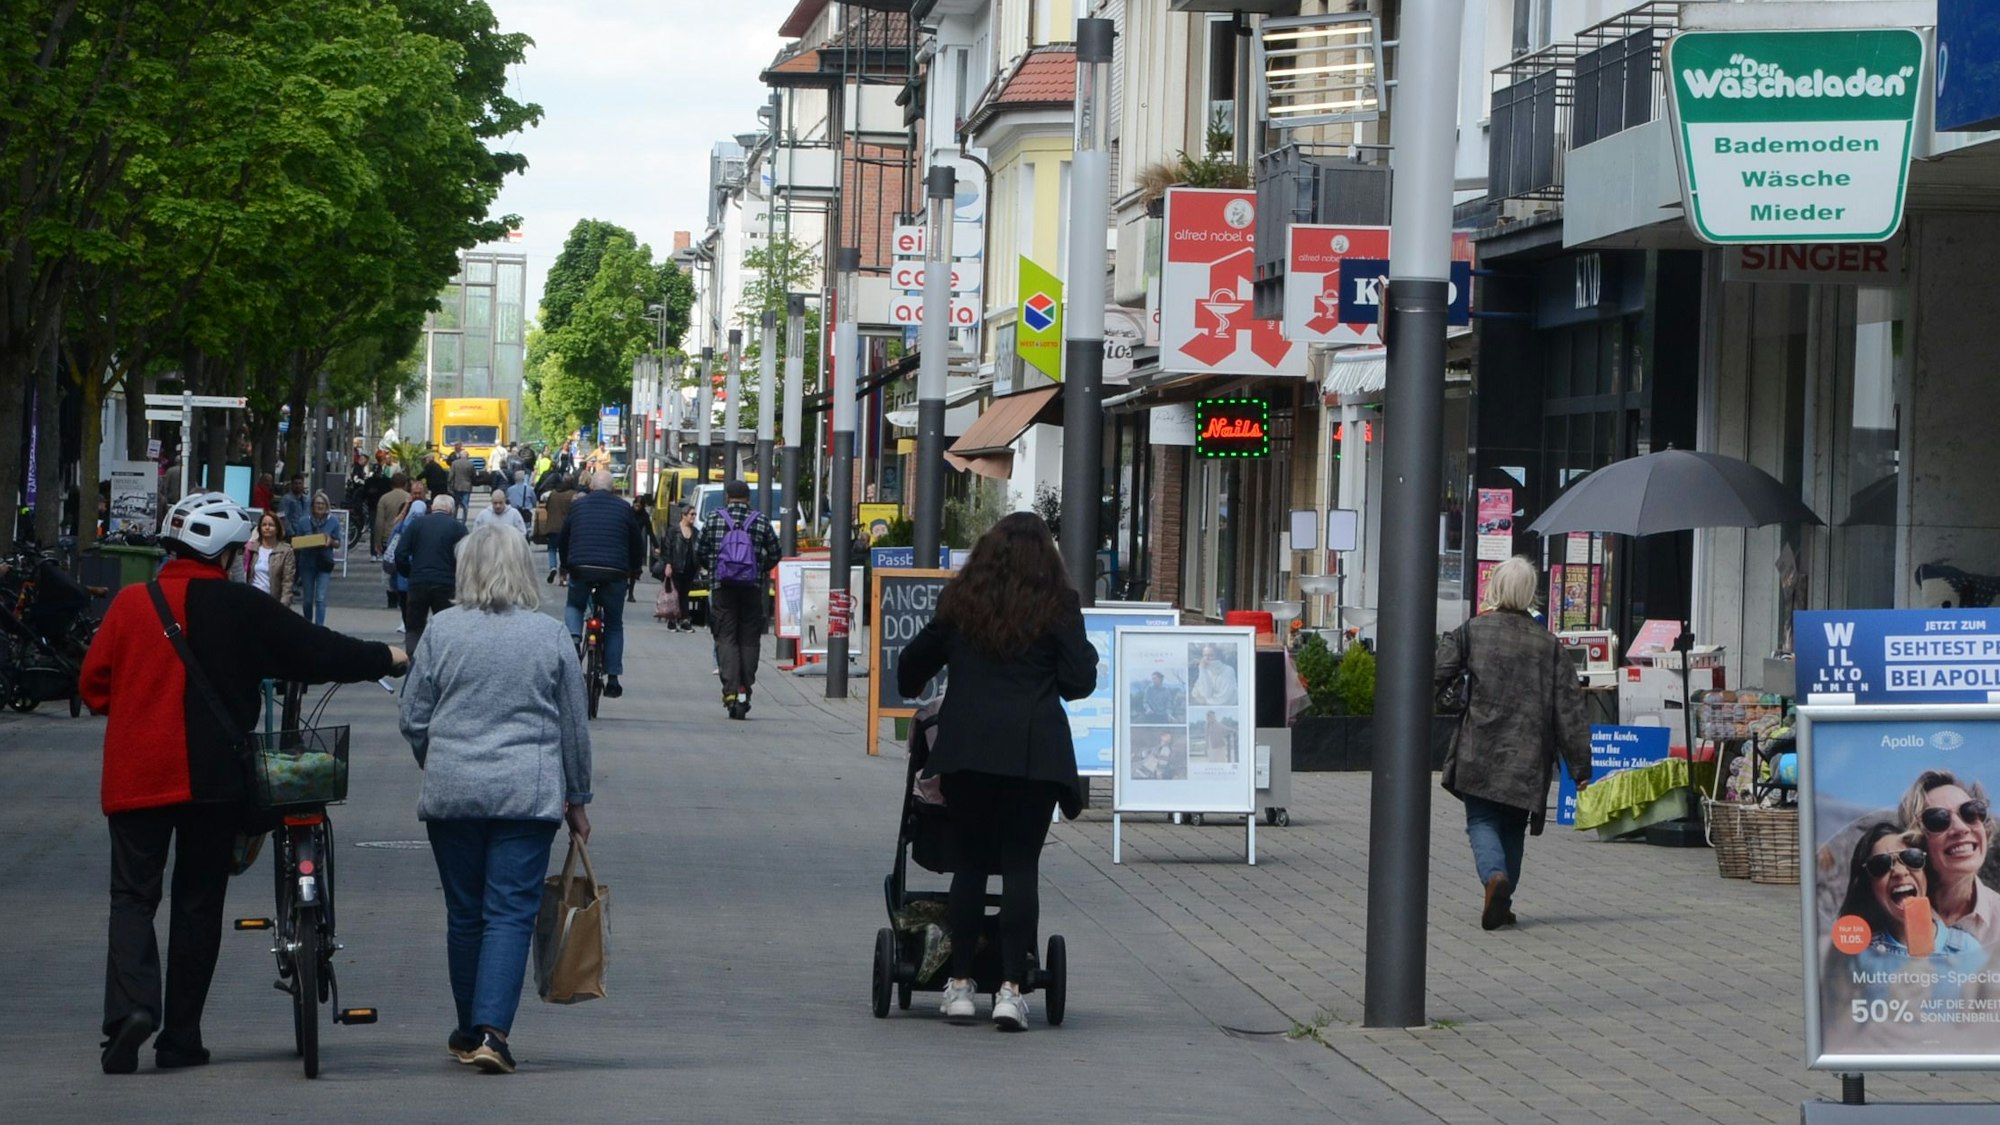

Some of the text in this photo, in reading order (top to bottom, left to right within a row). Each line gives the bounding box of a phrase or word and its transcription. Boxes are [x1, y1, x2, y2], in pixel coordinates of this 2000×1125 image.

[1714, 135, 1879, 154] Bademoden
[1741, 169, 1851, 188] Wäsche
[1750, 204, 1846, 221] Mieder
[1174, 229, 1207, 241] alfred
[1210, 230, 1242, 242] nobel
[1741, 244, 1889, 272] SINGER
[1201, 417, 1263, 438] Nails
[881, 584, 945, 610] ANGE
[884, 612, 931, 640] DÖN
[1924, 620, 1986, 631] JETZT ZUM
[1890, 641, 1976, 656] SEHTEST
[1891, 669, 1926, 687] BEI
[1881, 735, 1924, 750] Apollo
[1840, 935, 1863, 944] 11.05.
[1851, 999, 1914, 1023] 50%
[1920, 1000, 1943, 1010] AUF
[1946, 1000, 1965, 1010] DIE
